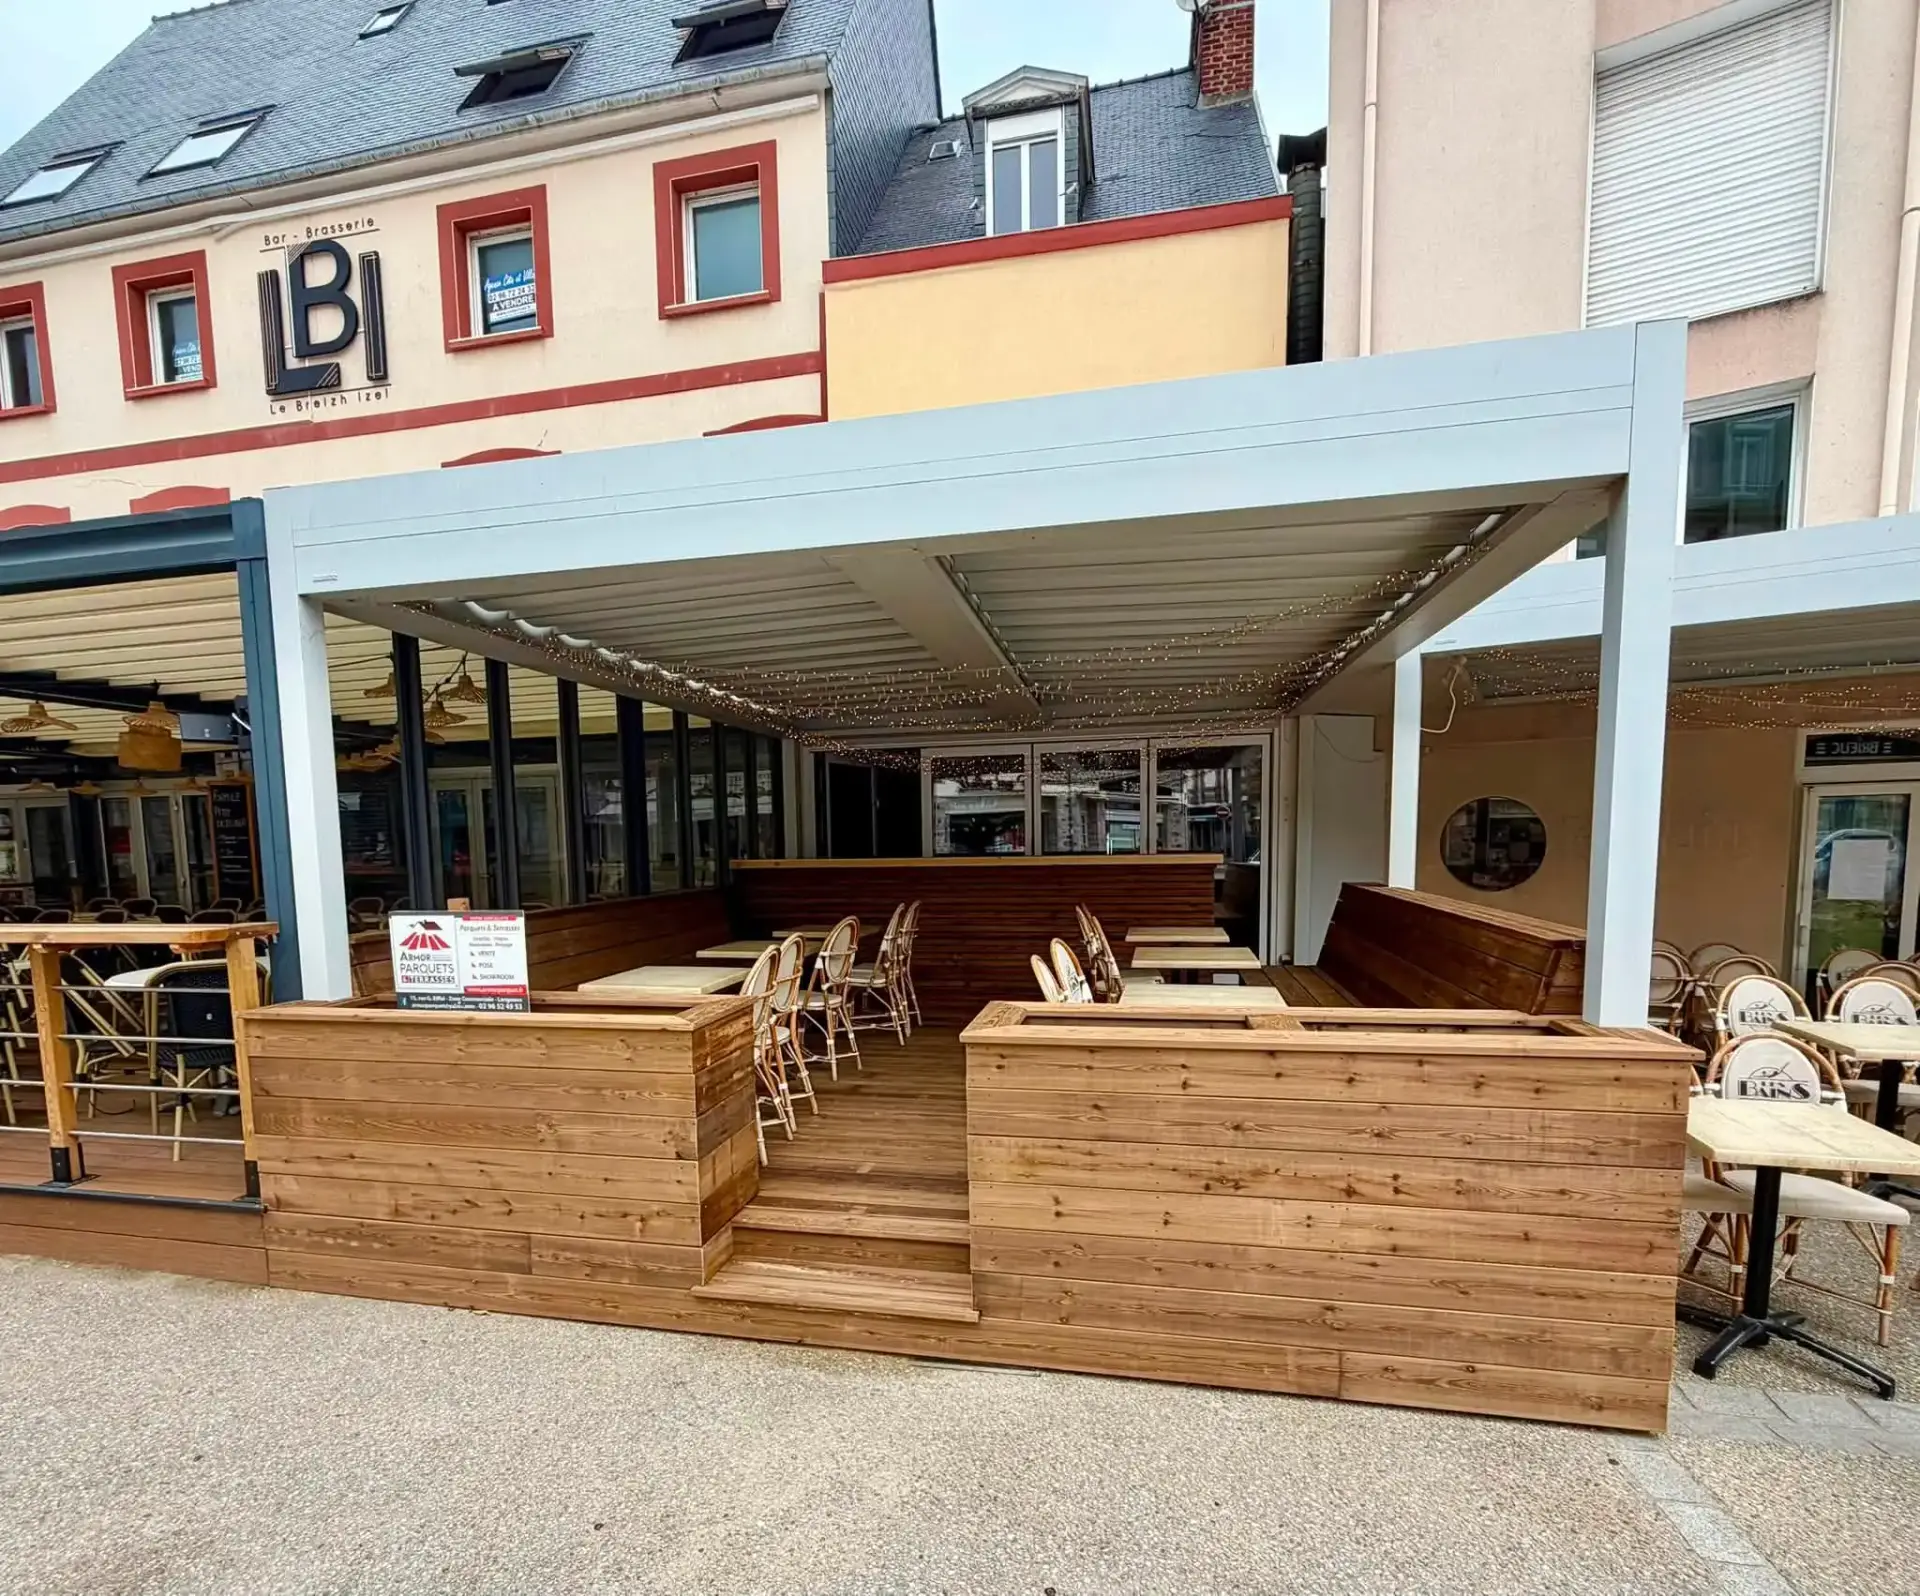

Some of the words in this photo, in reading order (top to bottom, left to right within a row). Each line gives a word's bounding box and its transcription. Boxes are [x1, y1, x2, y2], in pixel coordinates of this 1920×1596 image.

[264, 233, 287, 246] Bar
[305, 217, 375, 238] Brasserie
[493, 303, 499, 311] A
[499, 294, 534, 310] VENDRE
[270, 402, 287, 415] Le
[296, 394, 348, 411] Breizh
[357, 387, 390, 402] Izel
[400, 952, 432, 961] ARMOR
[400, 963, 455, 976] PARQUETS
[1737, 1079, 1812, 1100] BAINS
